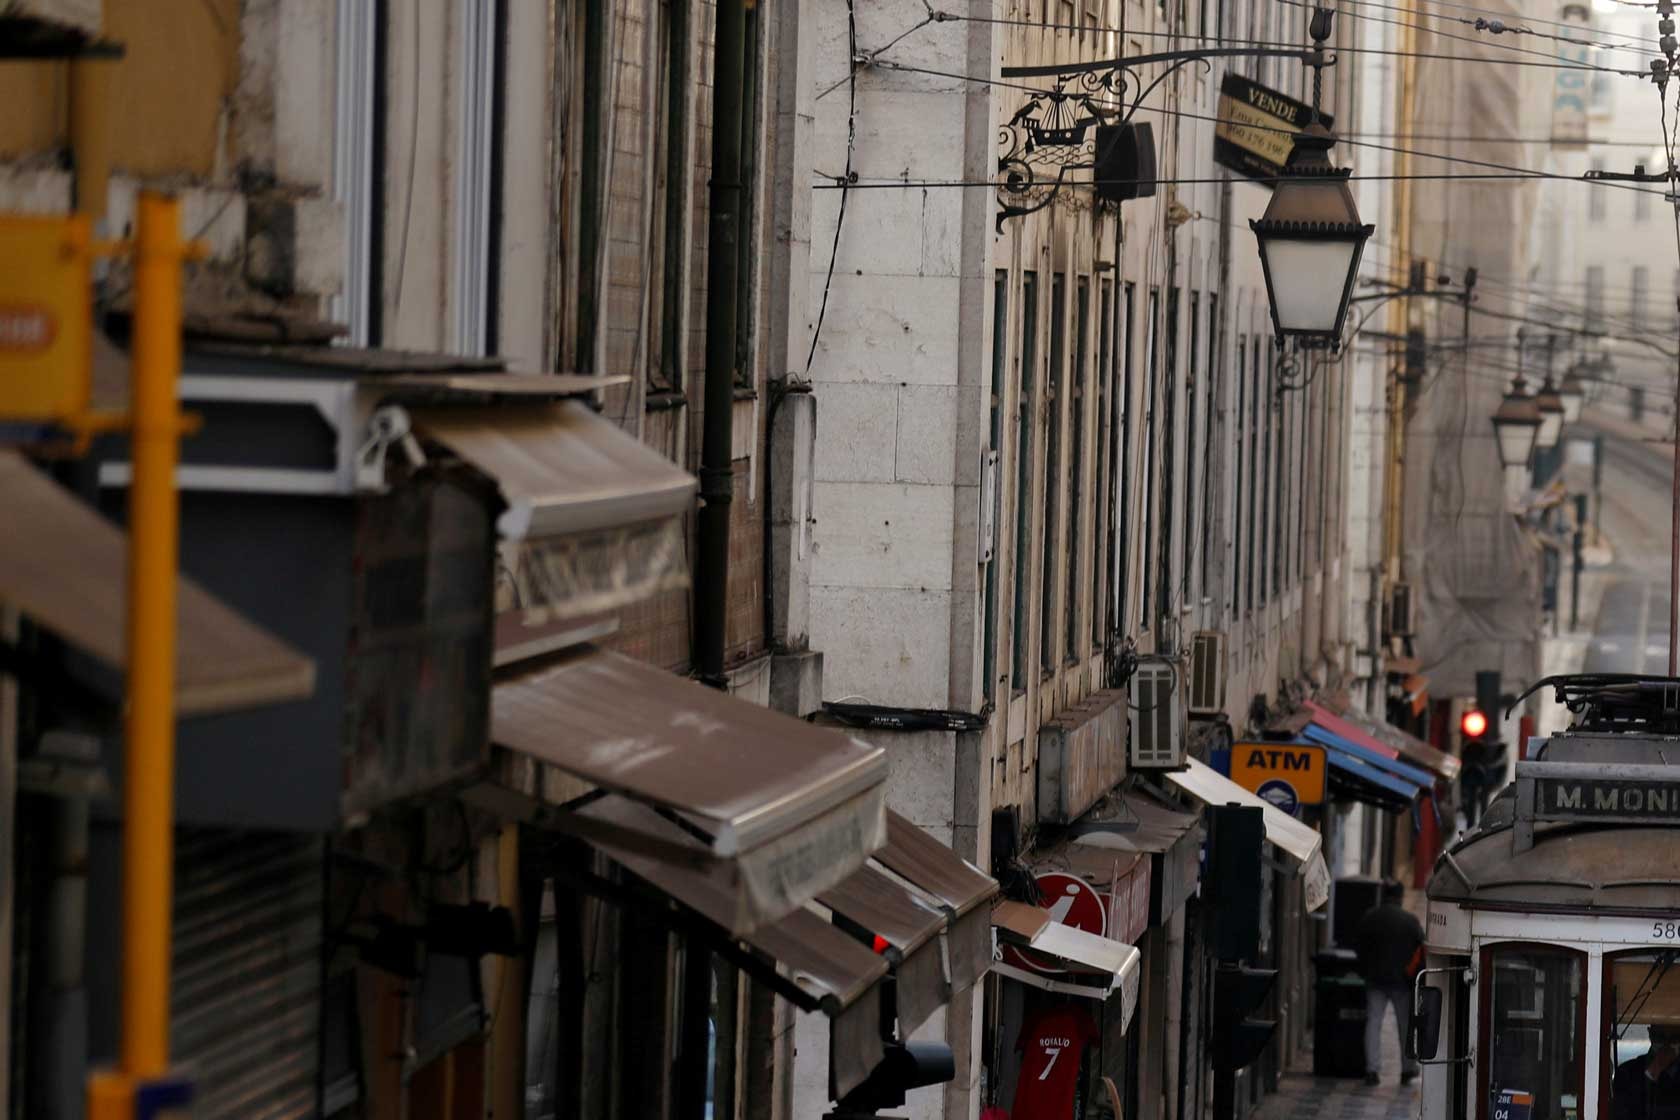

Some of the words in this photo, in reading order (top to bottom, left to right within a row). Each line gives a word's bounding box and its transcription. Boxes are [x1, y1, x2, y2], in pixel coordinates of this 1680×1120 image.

[1248, 87, 1296, 122] VENDE
[1247, 750, 1311, 771] ATM
[1038, 1048, 1061, 1080] 7
[1495, 1109, 1508, 1120] 04
